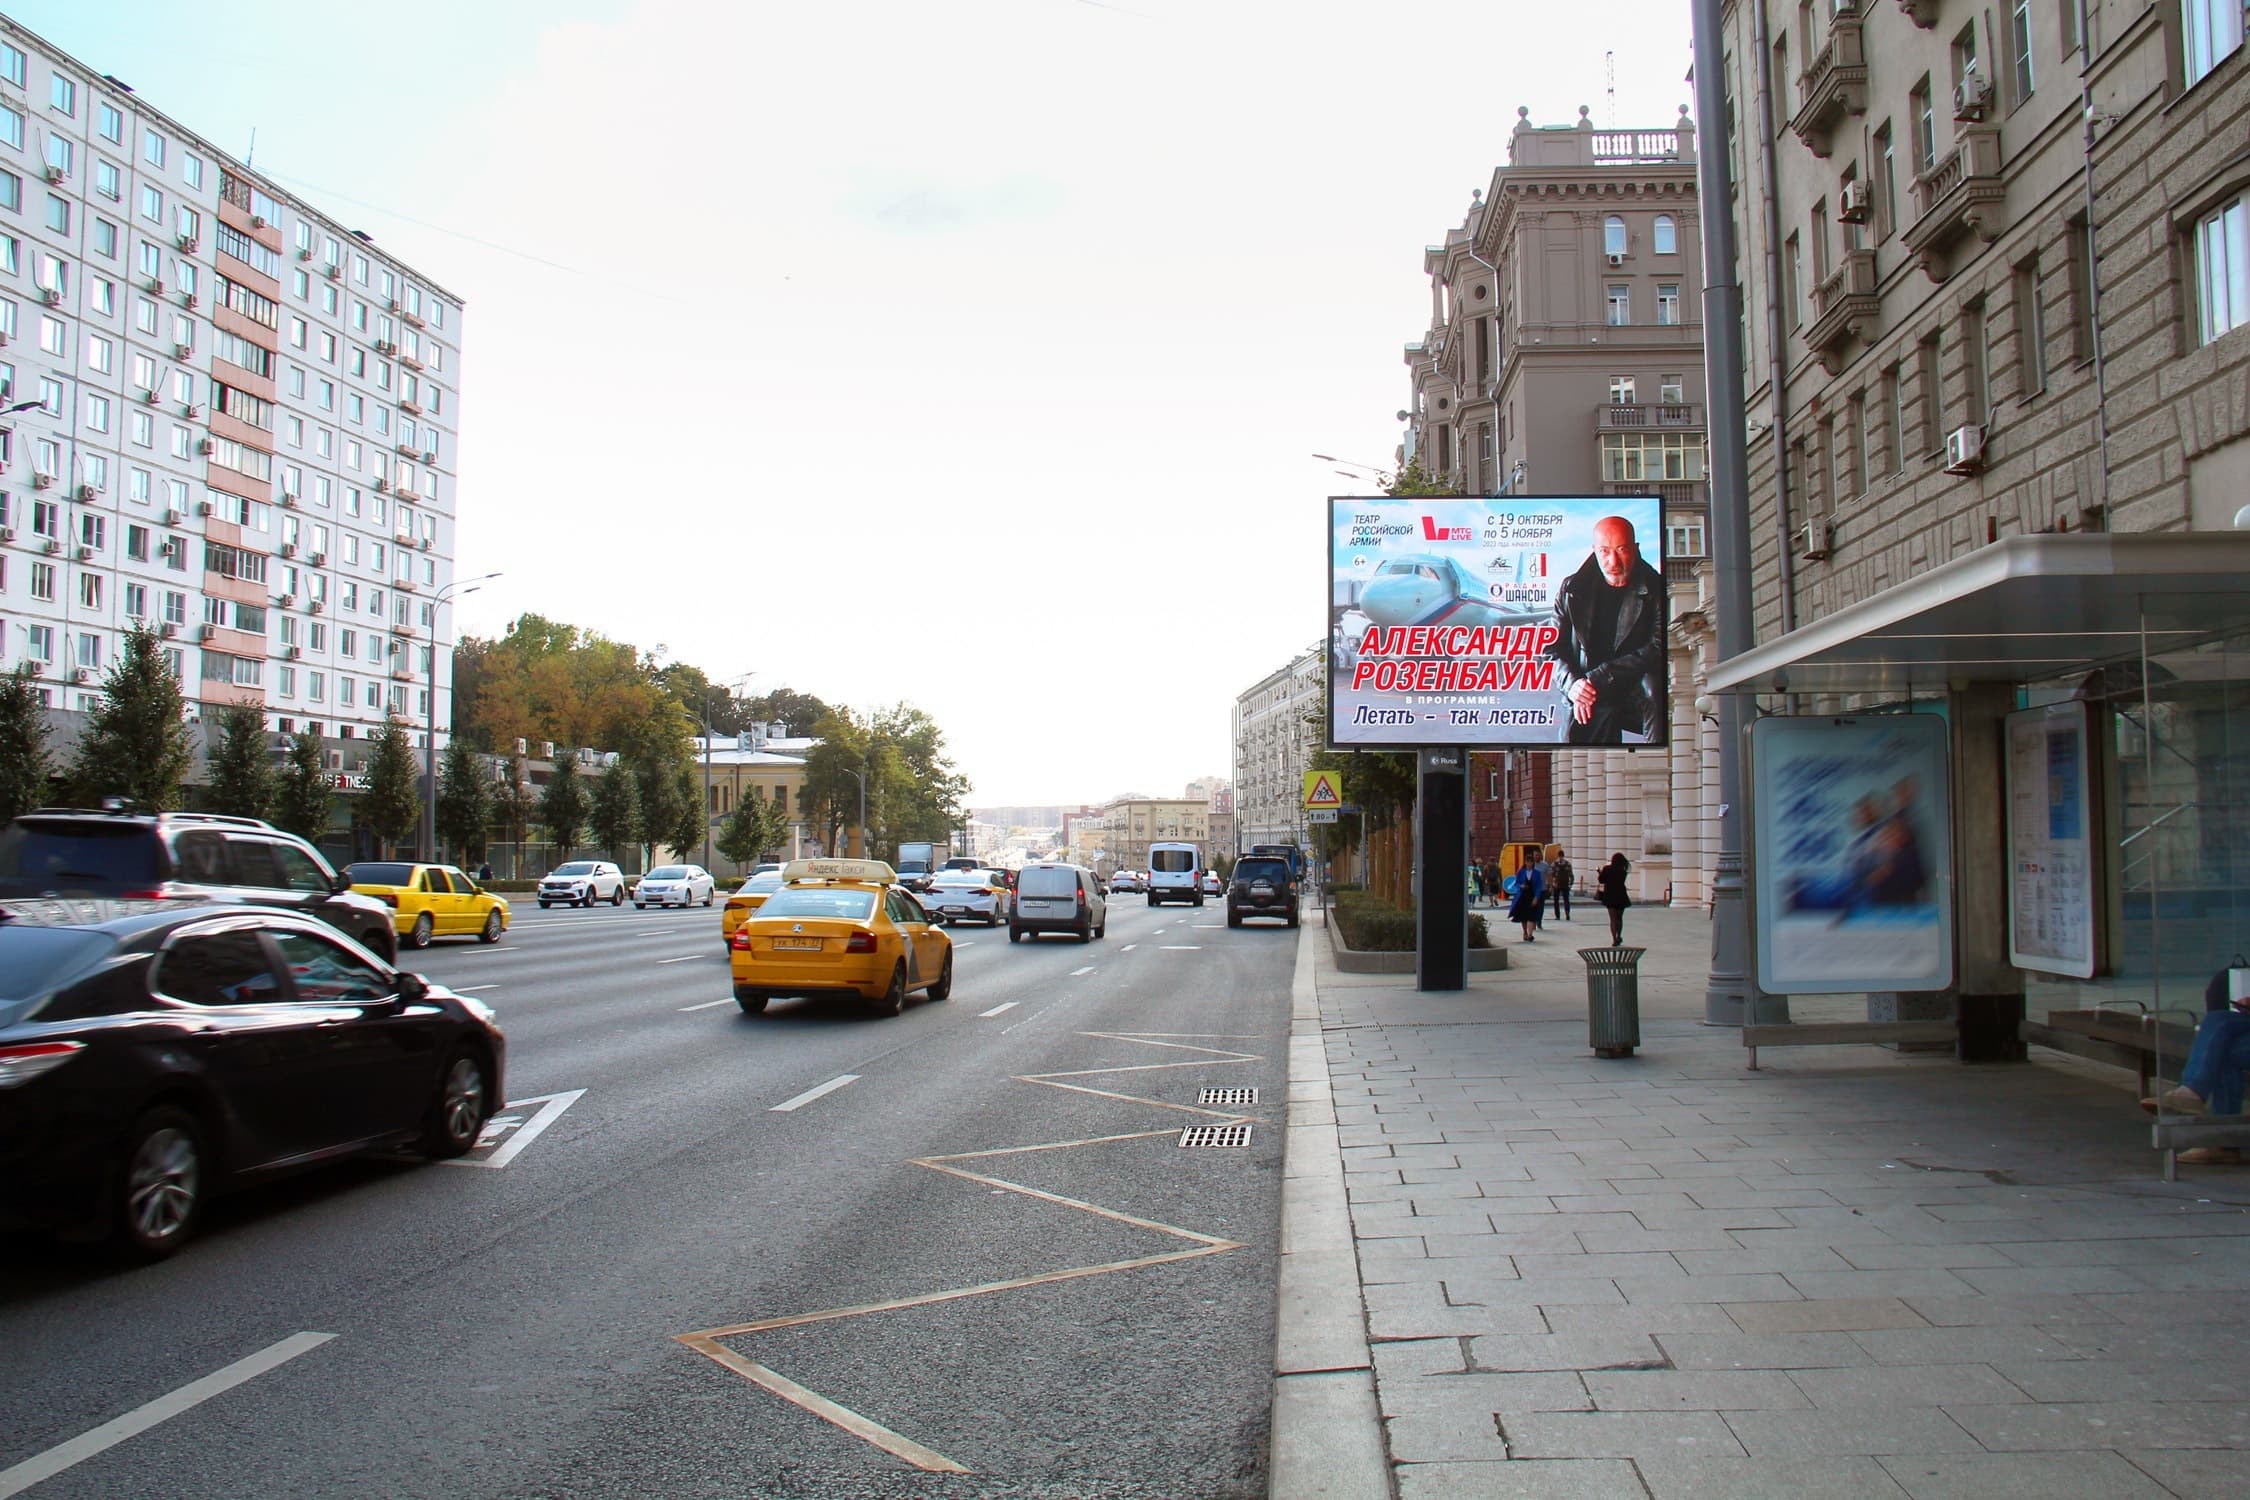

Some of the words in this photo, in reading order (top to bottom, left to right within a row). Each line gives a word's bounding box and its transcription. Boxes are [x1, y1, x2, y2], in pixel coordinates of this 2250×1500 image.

[1354, 514, 1381, 524] ТЕАТР
[1498, 513, 1515, 525] 19
[1517, 514, 1563, 525] ОКТЯБРЯ
[1351, 524, 1414, 536] РОССИЙСКОЙ
[1483, 529, 1497, 538] по
[1500, 526, 1509, 538] 5
[1511, 528, 1553, 538] НОЯБРЯ
[1348, 537, 1382, 547] АРМИИ
[1354, 556, 1367, 567] 6+
[1505, 589, 1547, 602] ШАНСОН
[1358, 625, 1559, 661] АЛЕКСАНДР
[1351, 661, 1555, 691] РОЗЕНБАУМ
[1405, 696, 1413, 705] В
[1418, 696, 1501, 705] ПРОГРАММЕ:
[1353, 705, 1415, 725] Летать
[1449, 709, 1480, 725] так
[1487, 705, 1556, 725] летать!
